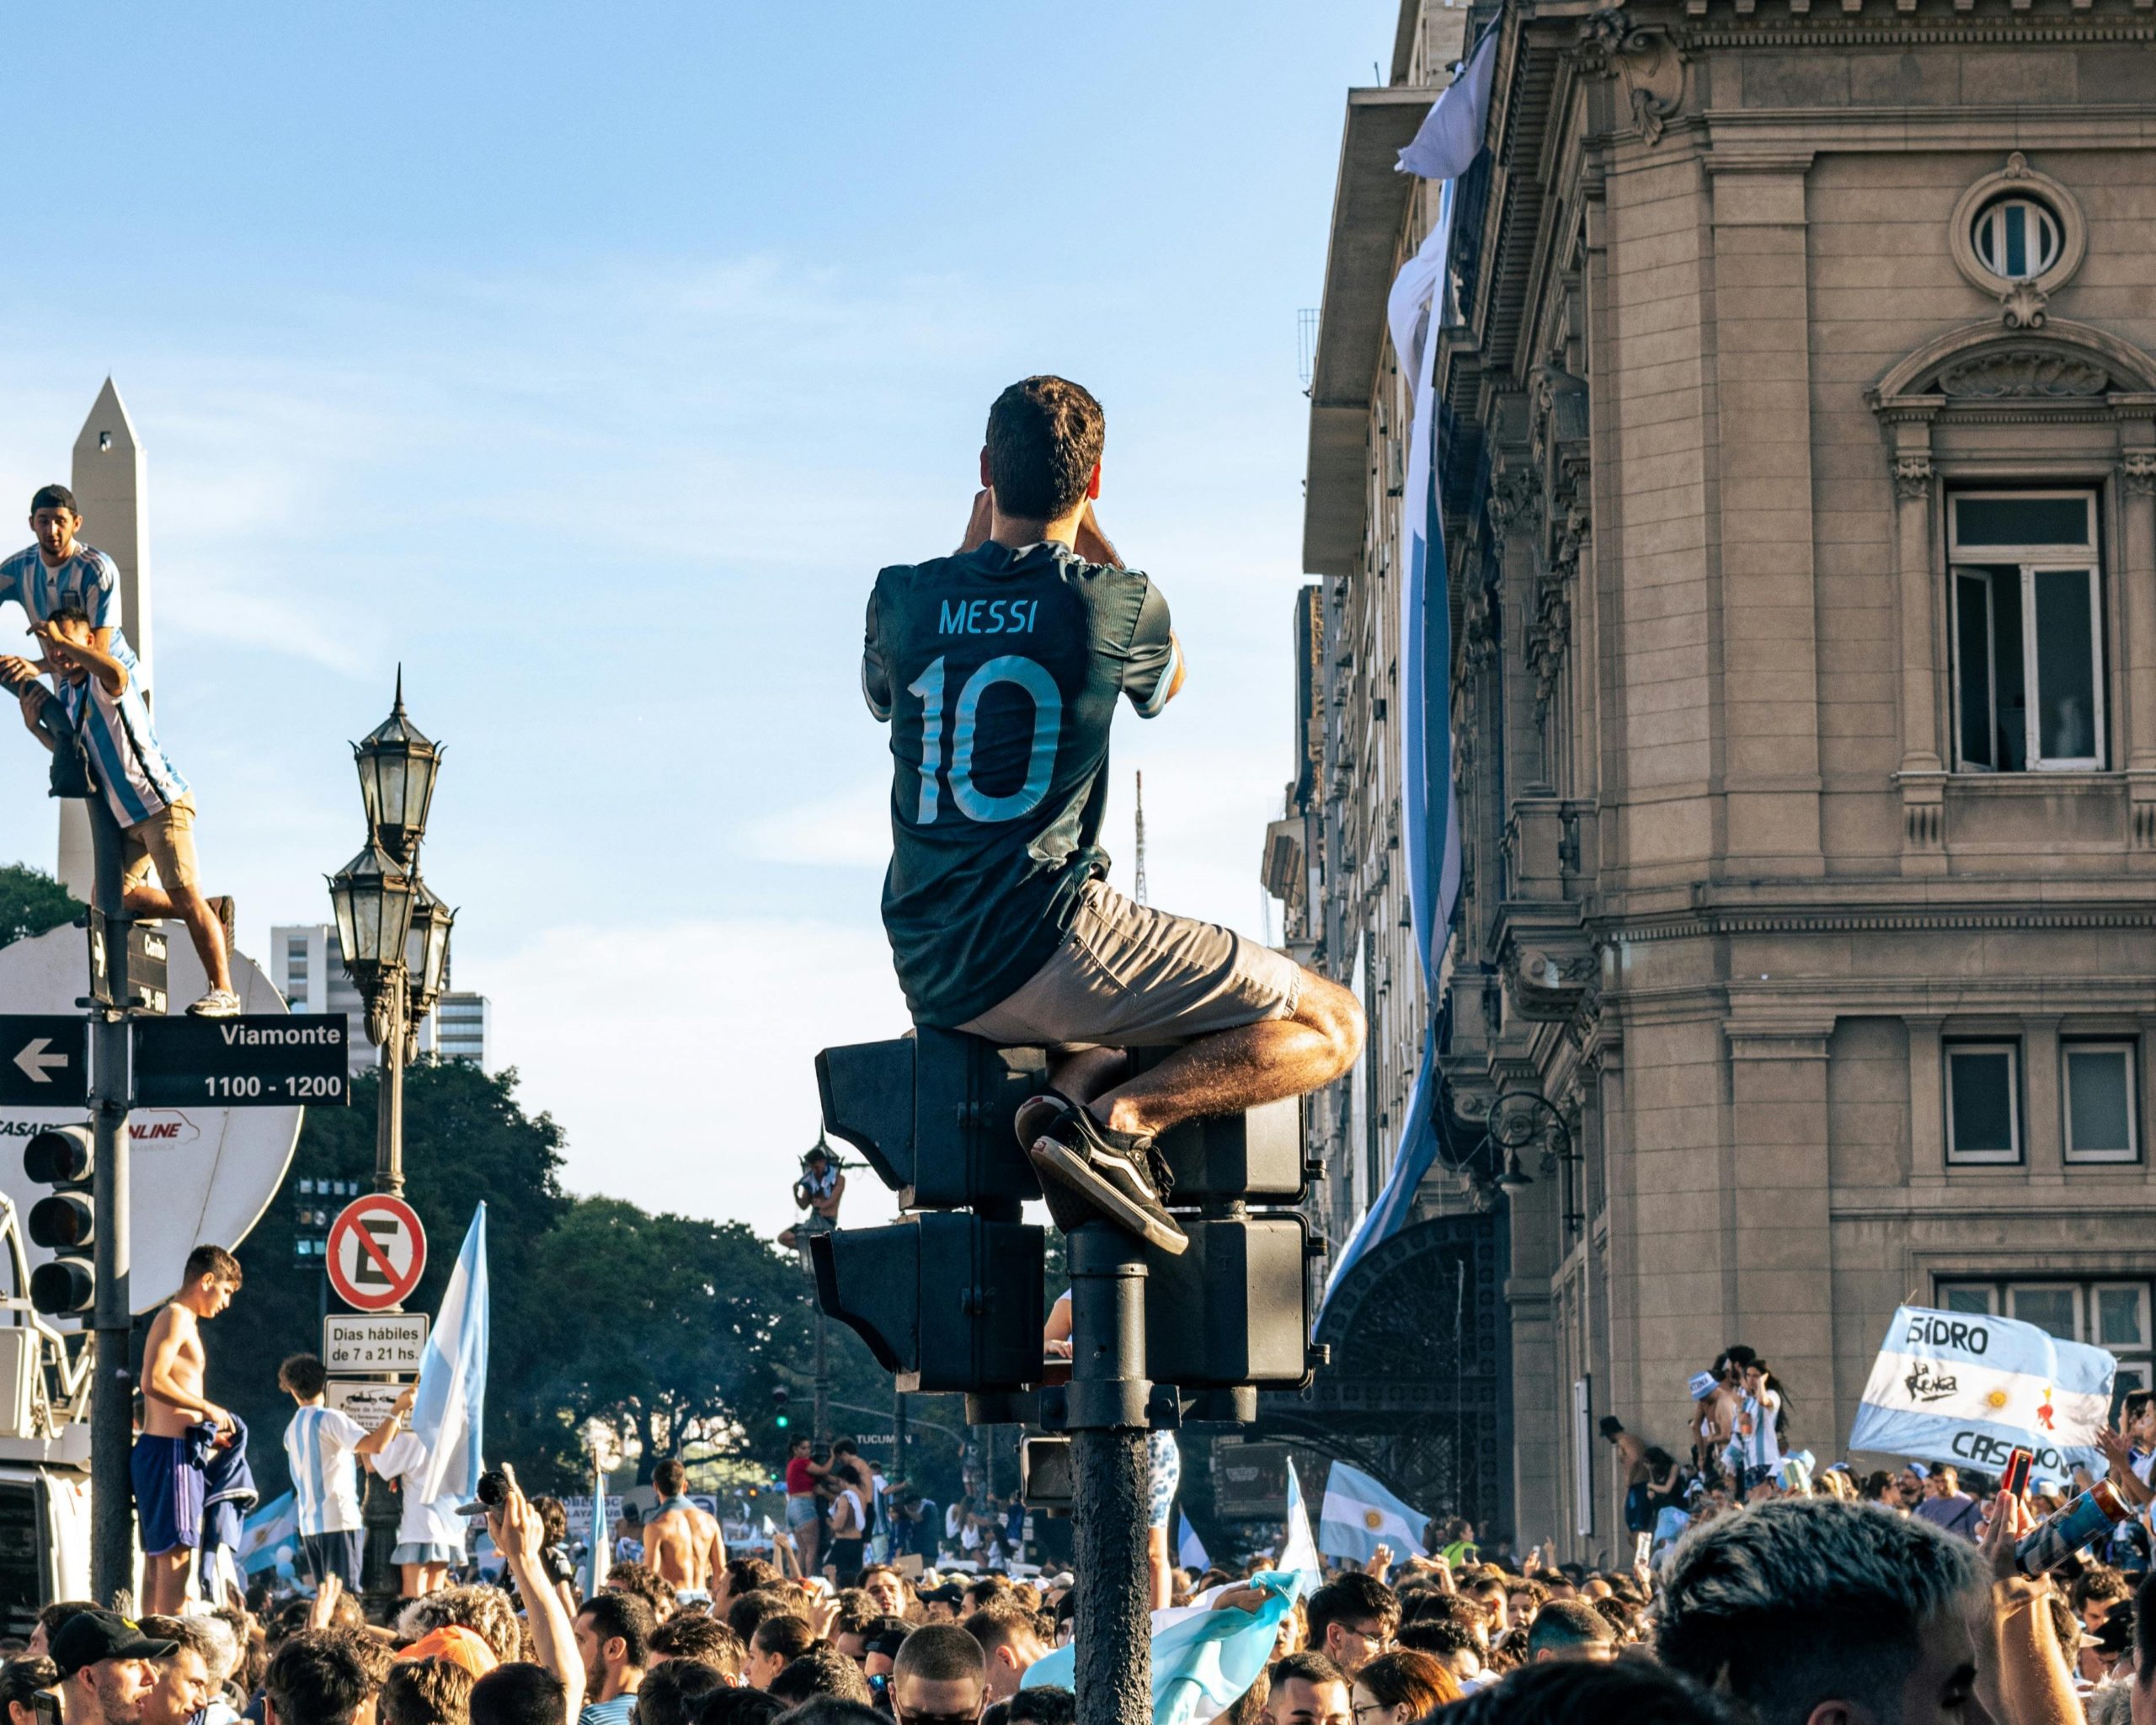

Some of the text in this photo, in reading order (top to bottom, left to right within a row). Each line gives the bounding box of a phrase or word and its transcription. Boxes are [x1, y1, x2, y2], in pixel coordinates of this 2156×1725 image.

[938, 599, 1038, 634] MESSI
[907, 654, 1063, 825] 10
[220, 1023, 341, 1045] Viamonte
[205, 1076, 261, 1097] 1100
[285, 1076, 341, 1097] 1200
[128, 1122, 183, 1140] NLINE
[368, 1327, 419, 1341] hábiles
[332, 1348, 349, 1361] de
[353, 1348, 361, 1360] 7
[377, 1347, 392, 1360] 21
[398, 1347, 419, 1360] hs.
[856, 1434, 913, 1445] TUCUMN
